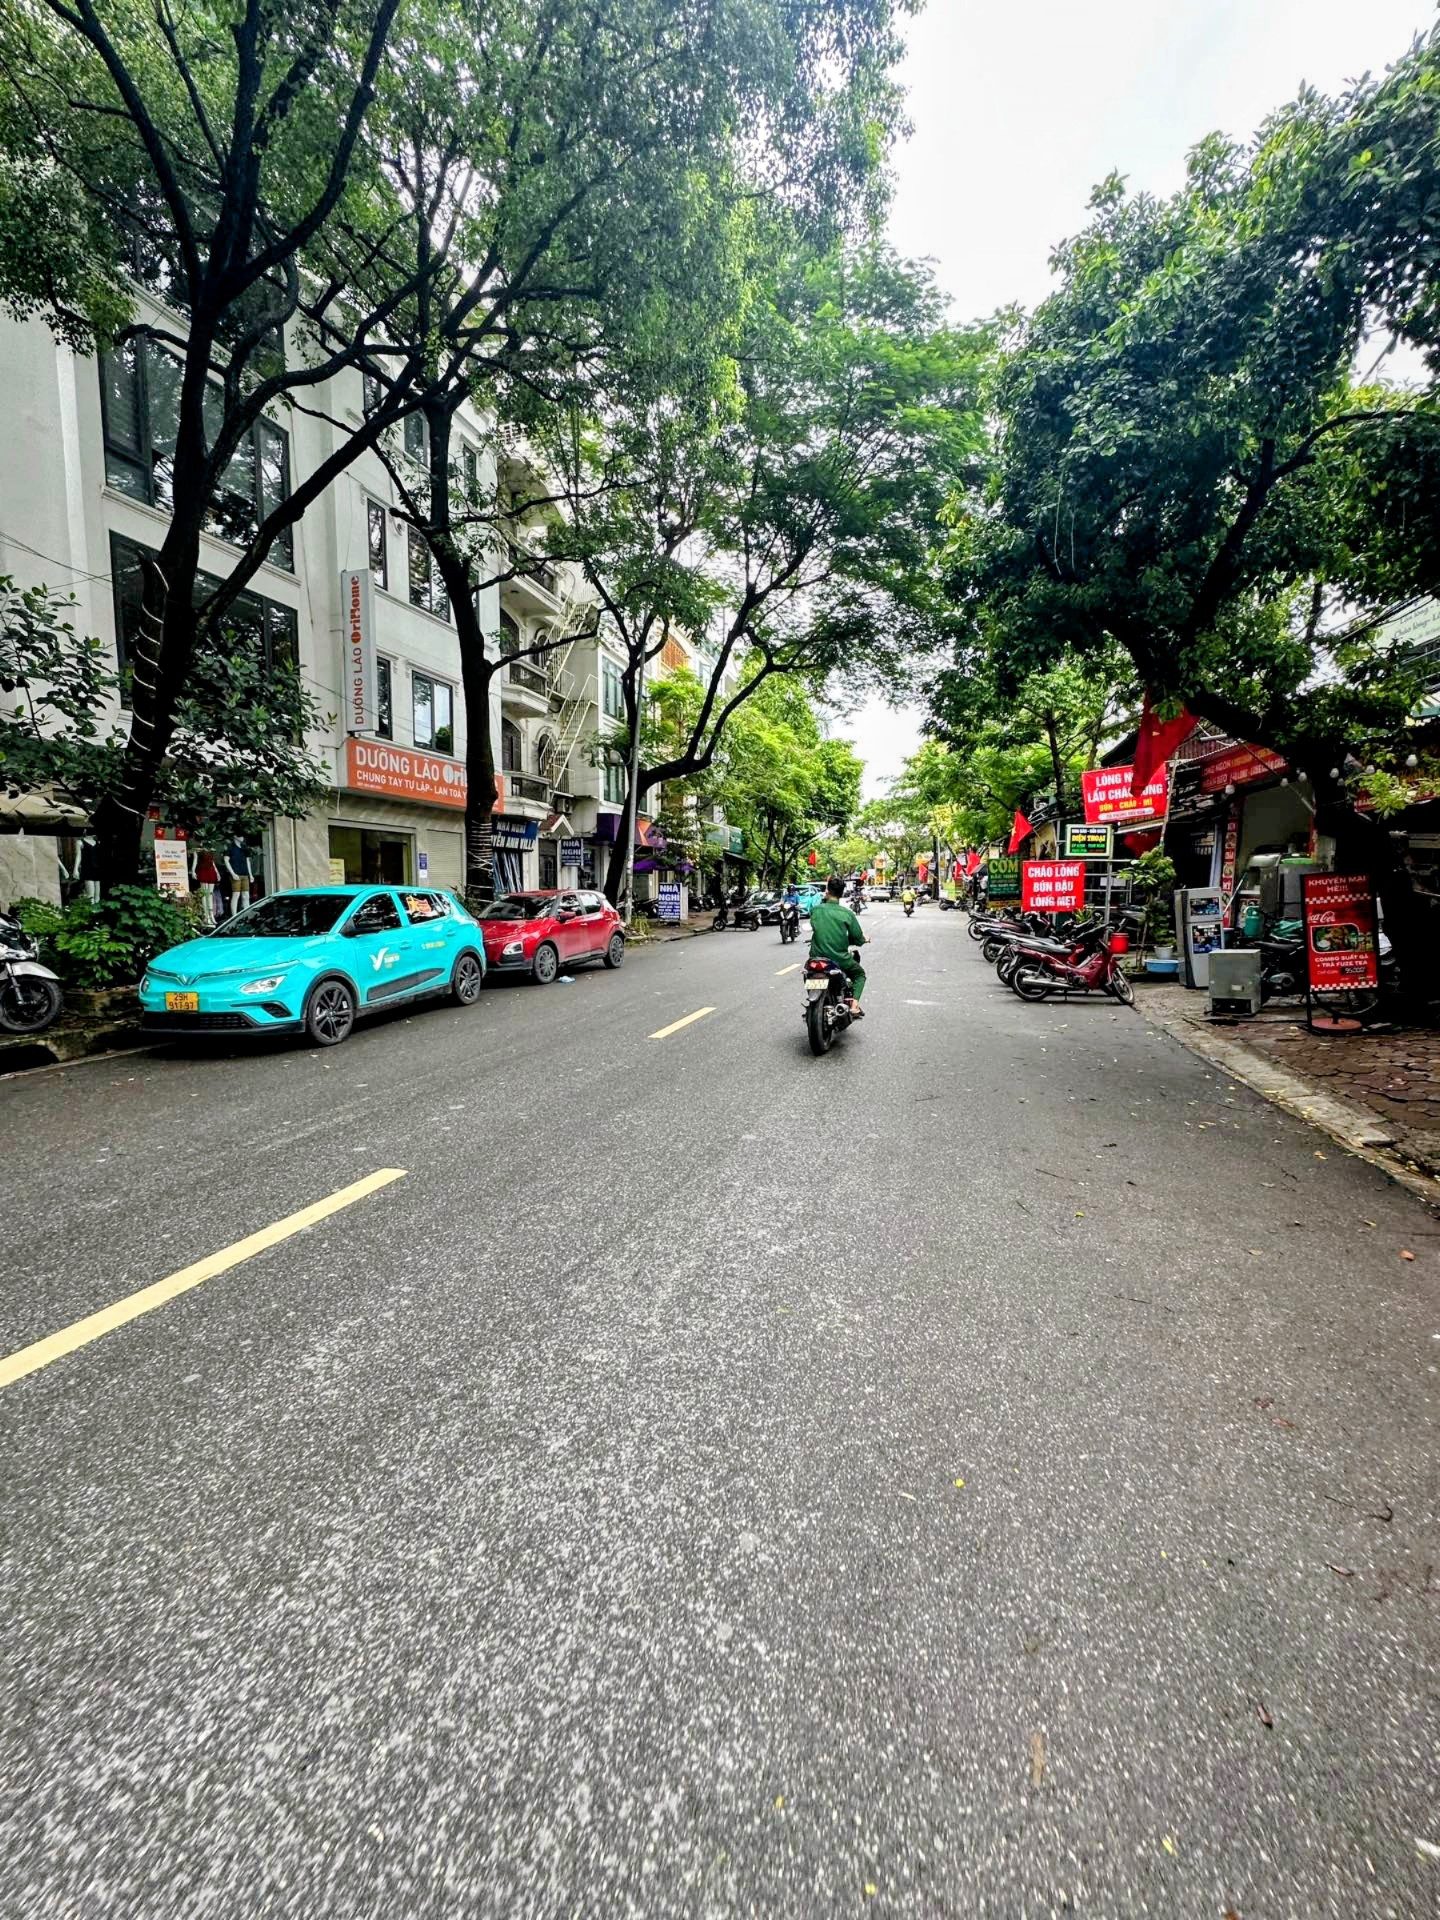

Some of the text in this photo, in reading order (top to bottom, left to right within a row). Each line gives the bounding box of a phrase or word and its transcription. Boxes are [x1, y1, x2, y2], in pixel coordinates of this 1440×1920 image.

[355, 745, 410, 775] DƯỠNG
[414, 758, 440, 781] LÃO
[356, 770, 387, 784] CHUNG
[388, 775, 403, 788] TAY
[434, 786, 448, 796] LAN
[1096, 773, 1122, 787] LÒNG
[1028, 865, 1054, 878] CHÁO
[1055, 864, 1080, 877] LÒNG
[660, 883, 679, 893] NHÀ
[1033, 880, 1053, 893] BÚN
[1055, 880, 1074, 894] ĐẬU
[1030, 894, 1077, 908] LÒNG MẸT
